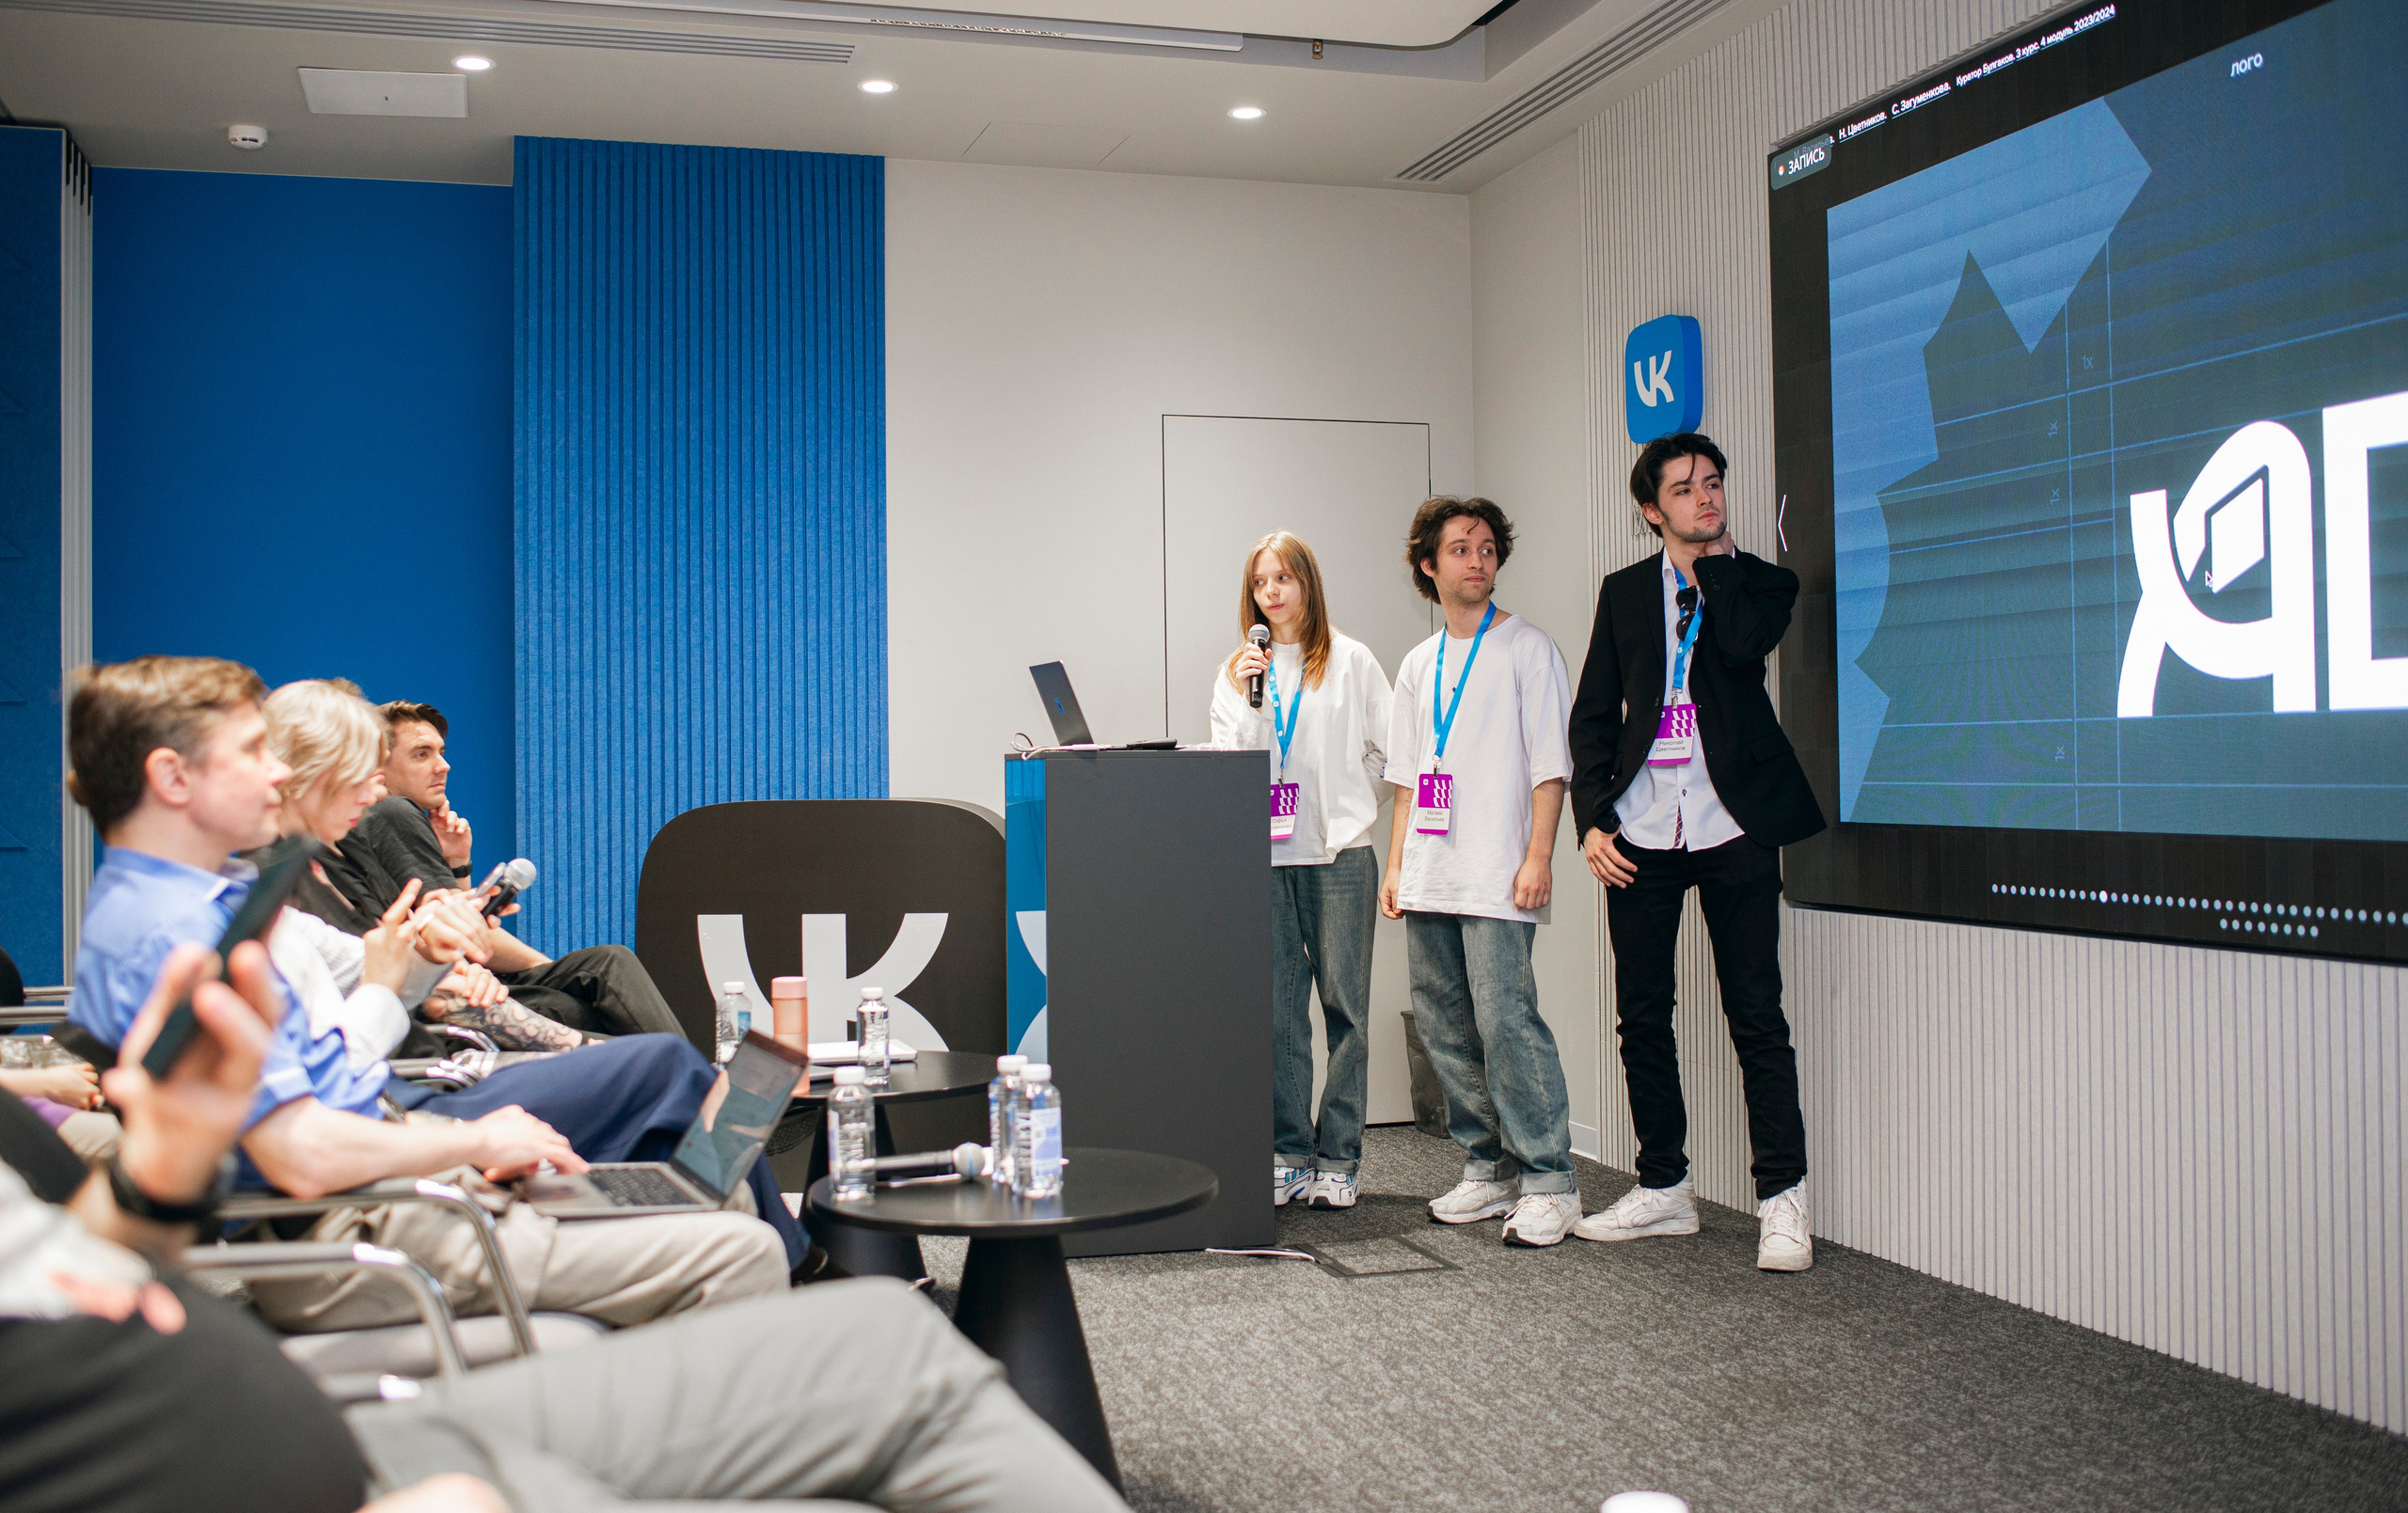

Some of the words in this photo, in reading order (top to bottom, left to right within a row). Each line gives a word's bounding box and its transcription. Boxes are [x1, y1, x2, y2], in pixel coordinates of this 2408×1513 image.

[1839, 127, 1847, 141] Н.
[1847, 111, 1887, 137] Цветников.
[1892, 102, 1900, 116] С.
[1900, 82, 1951, 113] Загуменкова.
[1956, 68, 1982, 87] Куратор
[1983, 53, 2015, 74] Булгаков.
[2016, 48, 2021, 59] 3
[2040, 36, 2047, 47] 4
[2047, 26, 2074, 44] модуль
[2074, 4, 2116, 32] 2023/2024
[2230, 53, 2263, 77] лого
[1788, 147, 1825, 175] ЗАПИСЬ
[1634, 350, 1674, 407] VK
[697, 912, 949, 1051] VK
